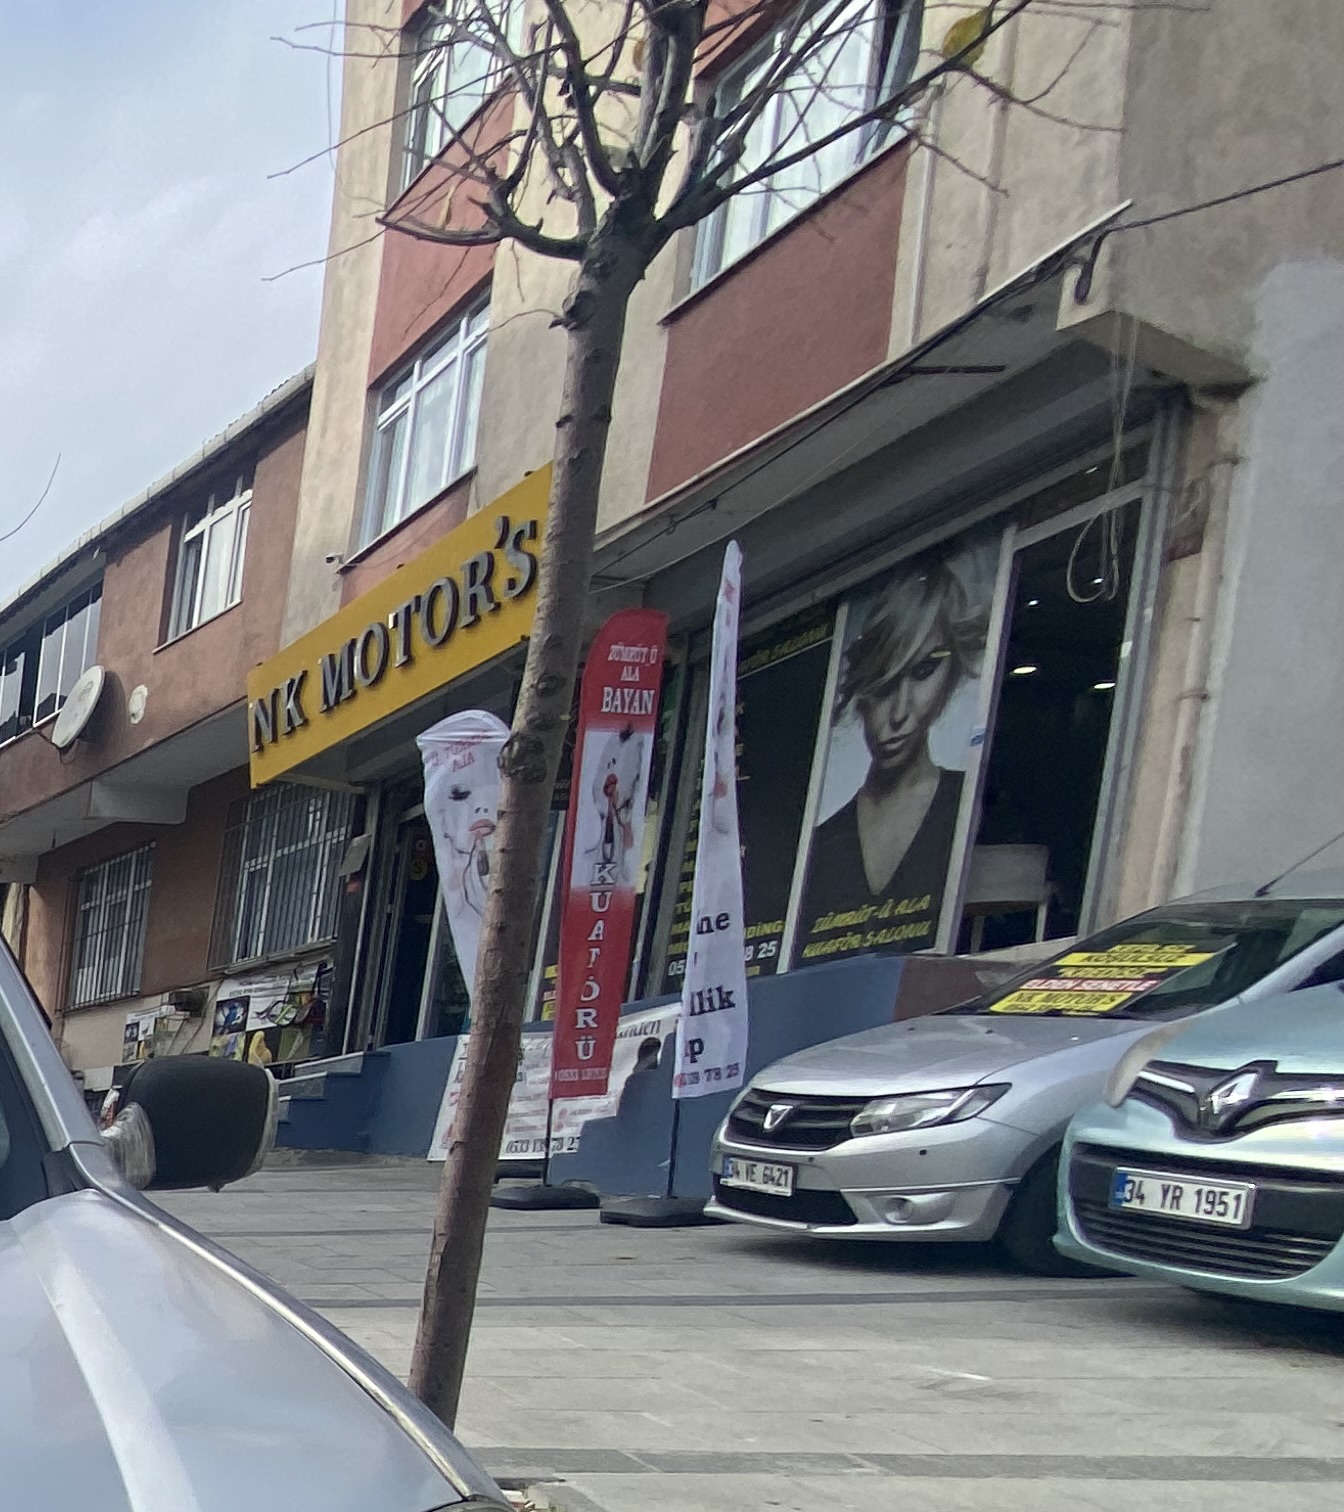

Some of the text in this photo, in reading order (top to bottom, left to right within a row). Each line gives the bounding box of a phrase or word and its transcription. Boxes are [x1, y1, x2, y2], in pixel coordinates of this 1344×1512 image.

[250, 515, 539, 753] NK MOTOR'S
[620, 665, 640, 682] ALA
[600, 687, 656, 715] BAYAN
[756, 940, 778, 960] 25
[762, 1165, 790, 1188] 6421
[1123, 1178, 1244, 1220] 34 YR 1951
